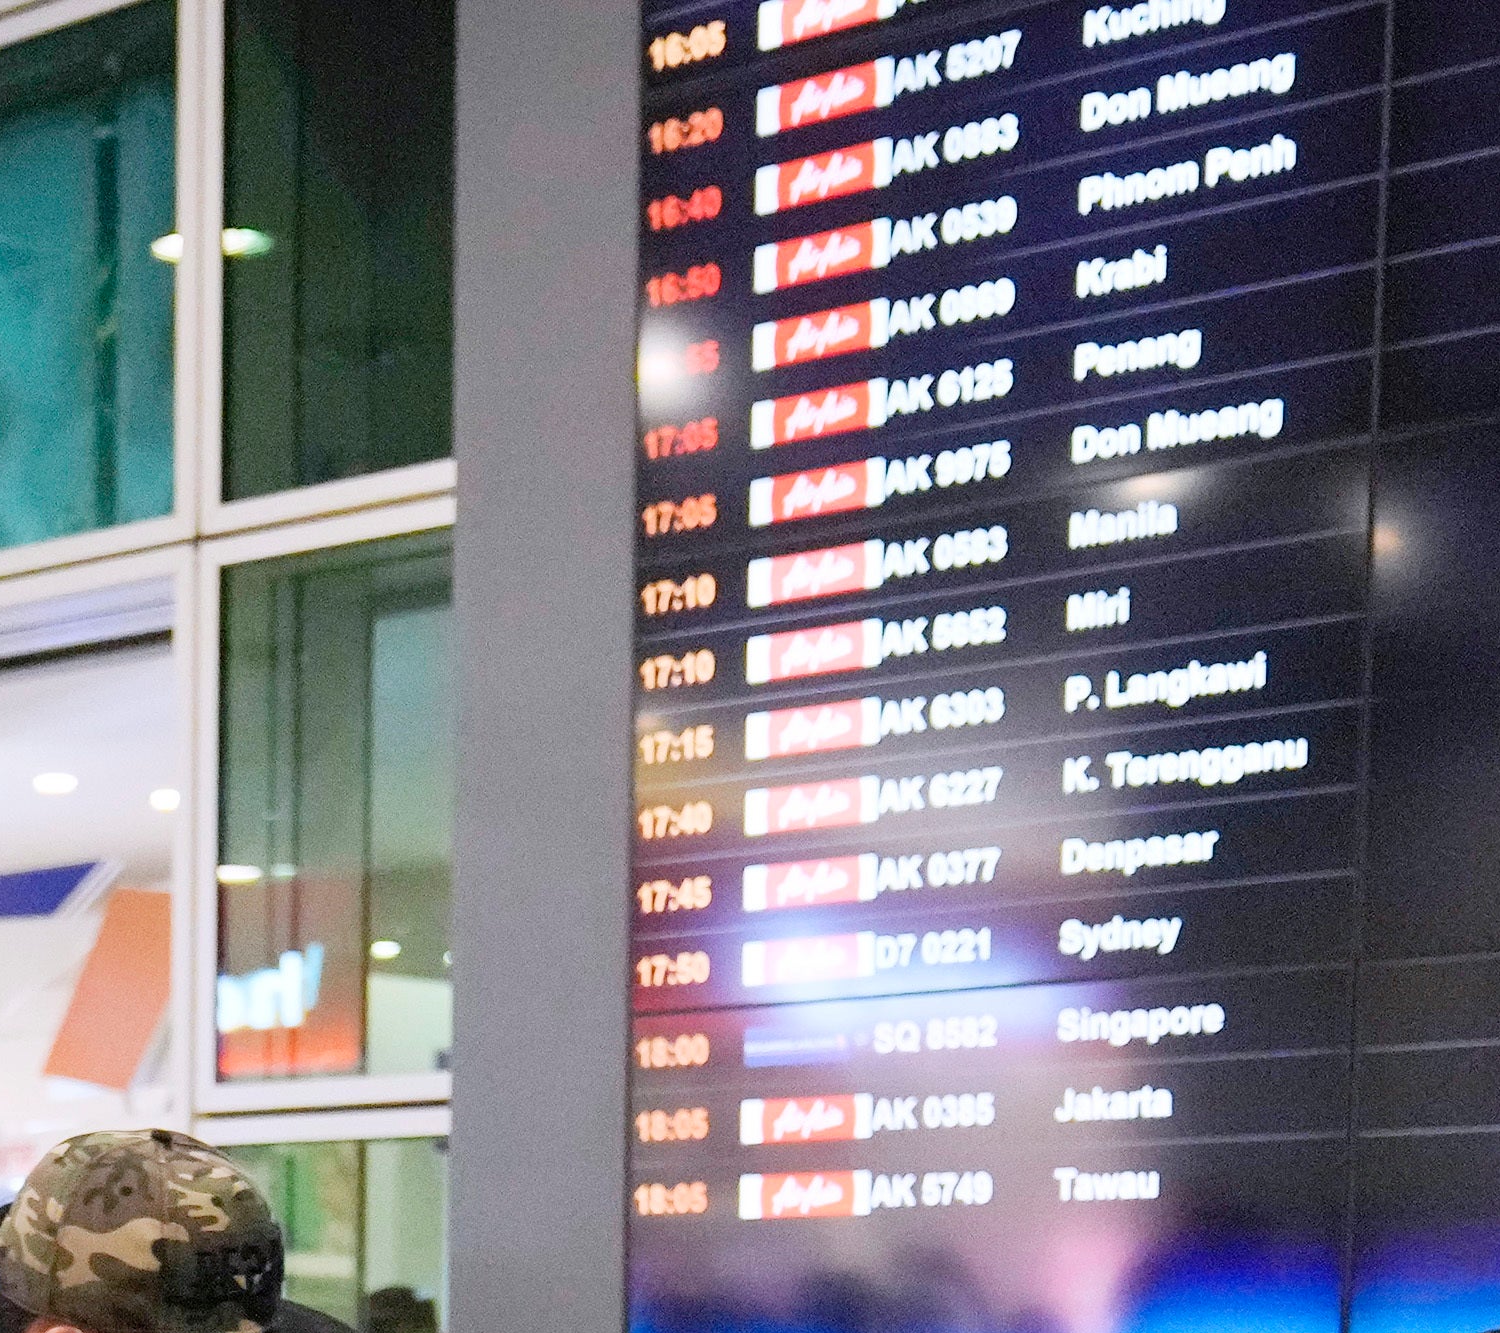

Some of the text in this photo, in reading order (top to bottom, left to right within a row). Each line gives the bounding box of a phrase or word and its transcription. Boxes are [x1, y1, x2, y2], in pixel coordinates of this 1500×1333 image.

[895, 50, 942, 97] AK
[945, 29, 1022, 82] 5207
[1081, 0, 1227, 48] Kuching
[892, 130, 940, 176] AK
[1080, 87, 1151, 132] Don
[891, 212, 938, 257] AK
[1078, 160, 1199, 216] Phnom
[1205, 134, 1297, 188] Penh
[889, 294, 936, 338] AK
[1076, 244, 1168, 298] Krabi
[888, 373, 935, 417] AK
[935, 358, 1014, 406] 6125
[1073, 328, 1202, 382] Penang
[885, 454, 933, 498] AK
[1071, 423, 1142, 464] Don
[641, 573, 717, 616] 17:10
[884, 537, 930, 579] AK
[1068, 500, 1178, 550] Manila
[640, 648, 716, 691] 17:10
[883, 617, 929, 657] AK
[1066, 586, 1130, 631] Miri
[639, 724, 715, 765] 17:15
[881, 697, 927, 736] AK
[1064, 674, 1100, 713] P.
[1105, 651, 1267, 708] Langkawi
[638, 801, 713, 841] 17:40
[879, 776, 925, 814] AK
[1063, 755, 1100, 794] K.
[1105, 737, 1309, 787] Terengganu
[637, 876, 712, 913] 17:45
[878, 855, 923, 893] AK
[1060, 830, 1220, 876] Denpasar
[636, 951, 711, 988] 17:50
[875, 934, 916, 969] D7
[921, 927, 992, 965] 0221
[1058, 915, 1183, 961] Sydney
[874, 1020, 921, 1054] SQ
[1057, 1003, 1225, 1047] Singapore
[873, 1098, 919, 1133] AK
[1054, 1085, 1173, 1124] Jakarta
[871, 1174, 916, 1208] AK
[921, 1170, 994, 1205] 5749
[1054, 1167, 1160, 1202] Tawau
